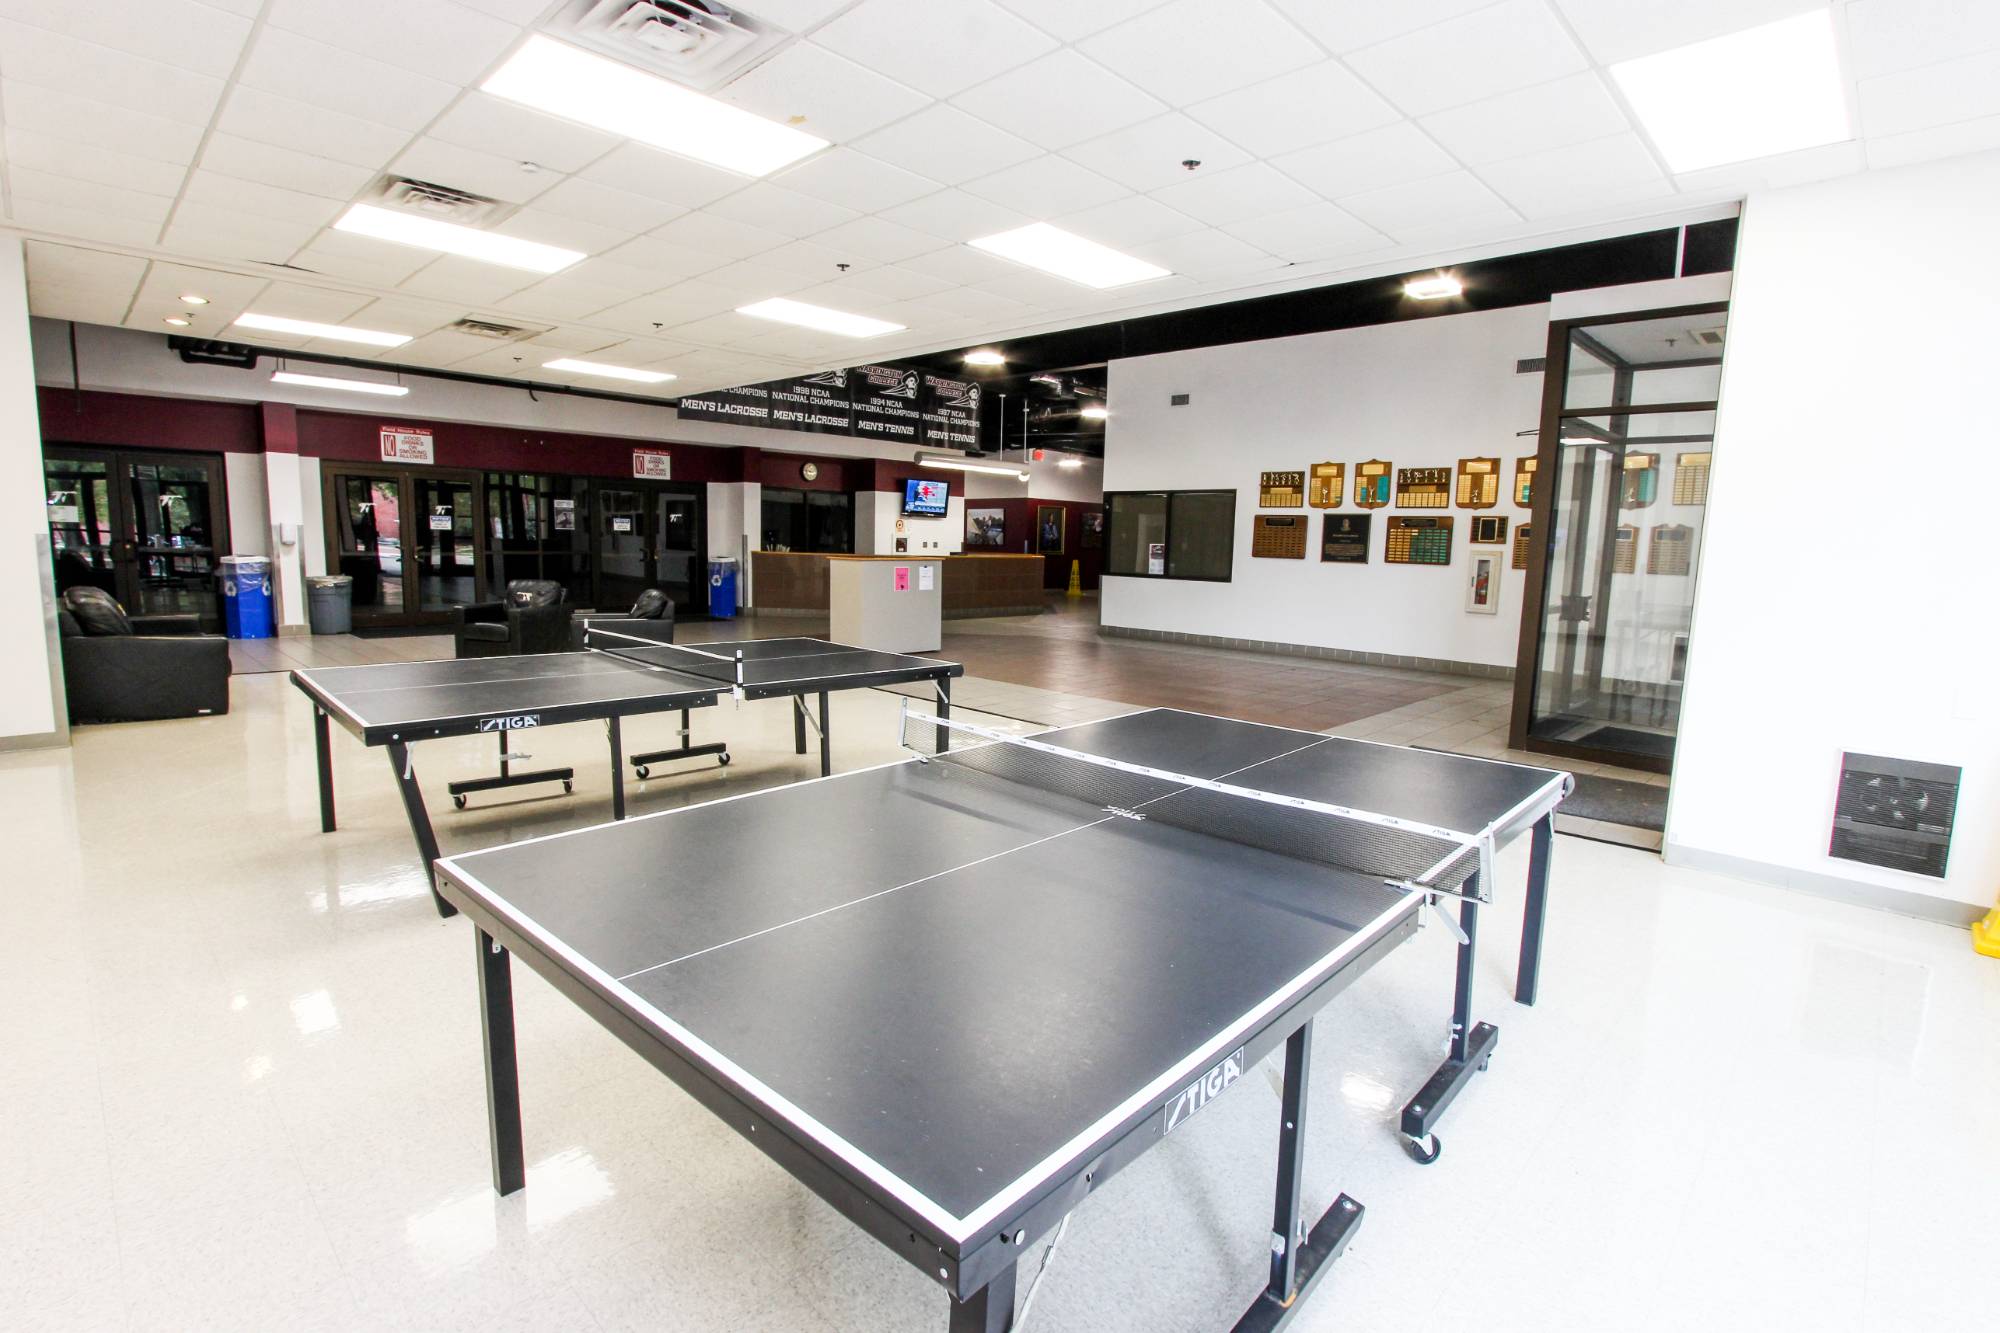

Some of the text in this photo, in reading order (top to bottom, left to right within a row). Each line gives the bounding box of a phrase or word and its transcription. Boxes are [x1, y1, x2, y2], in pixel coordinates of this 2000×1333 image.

[857, 364, 903, 379] WASHINGTON
[772, 391, 850, 409] NATIONAL CHAMPIONS
[811, 389, 831, 398] NCAA
[681, 398, 769, 418] MEN'S LACROSSE
[852, 402, 920, 419] NATIONAL CHAMPIONS
[886, 399, 903, 409] NCAA
[773, 409, 849, 427] MEN'S LACROSSE
[922, 413, 950, 424] NATIONAL
[951, 410, 966, 418] NCAA
[858, 420, 915, 436] MEN'S TENNIS
[927, 429, 976, 443] MEN'S TENNIS
[384, 435, 396, 456] NO
[483, 716, 537, 731] STIGA
[1168, 1055, 1240, 1130] STIGA
